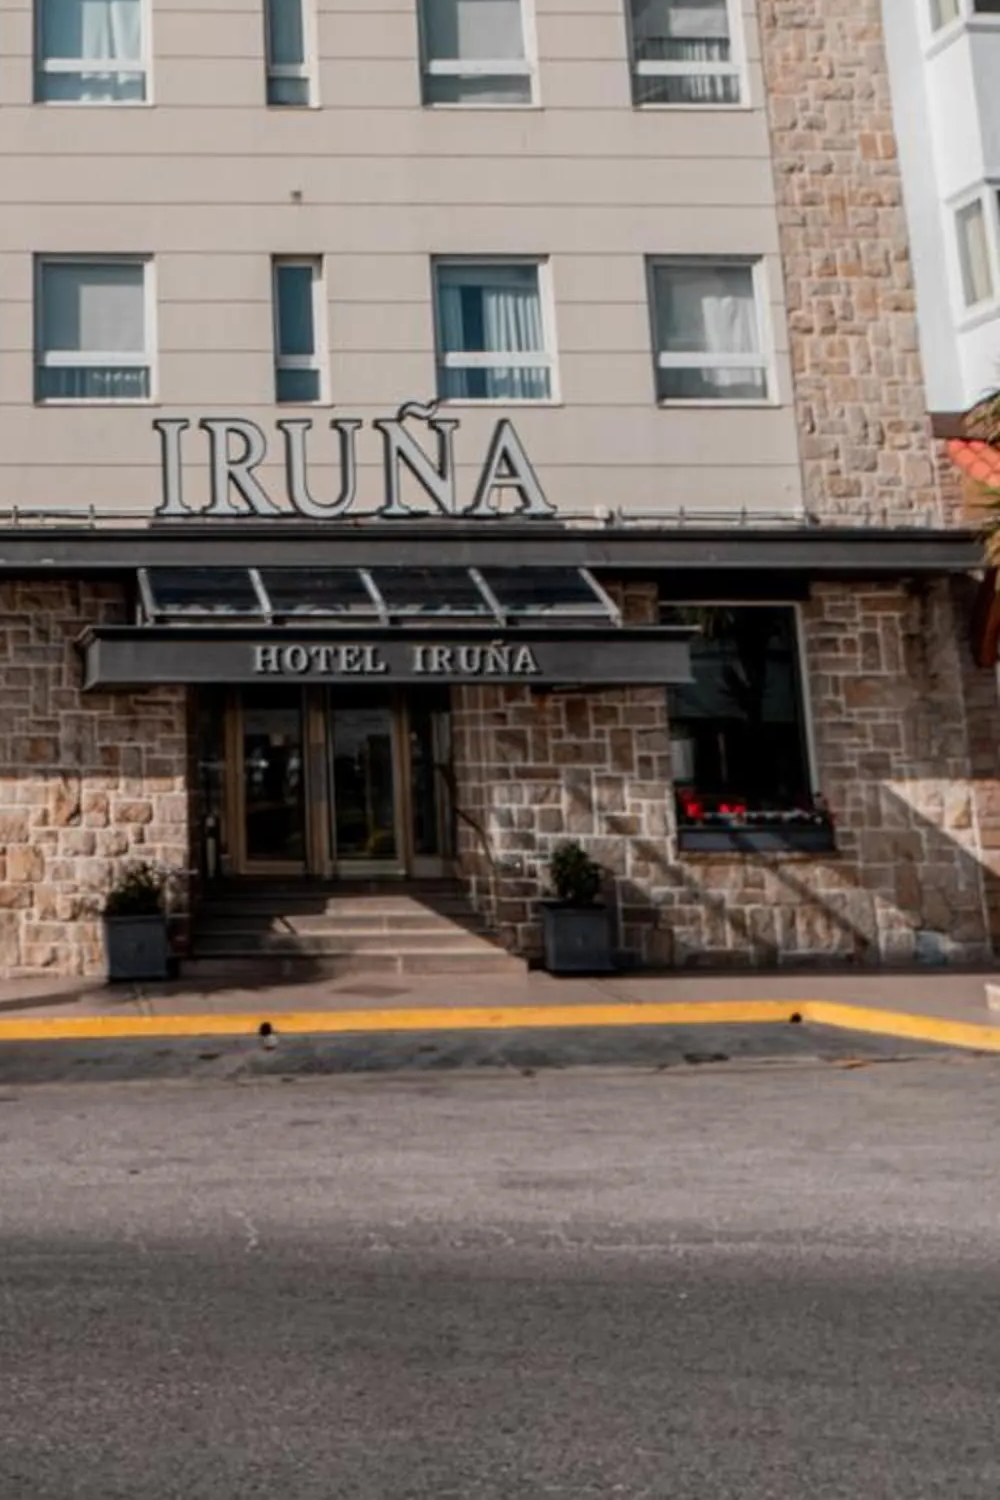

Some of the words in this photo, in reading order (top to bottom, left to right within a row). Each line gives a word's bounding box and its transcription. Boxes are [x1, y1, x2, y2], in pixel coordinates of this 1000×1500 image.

[152, 397, 559, 518] IRUÑA
[254, 644, 388, 673] HOTEL
[412, 639, 539, 673] IRUÑA
